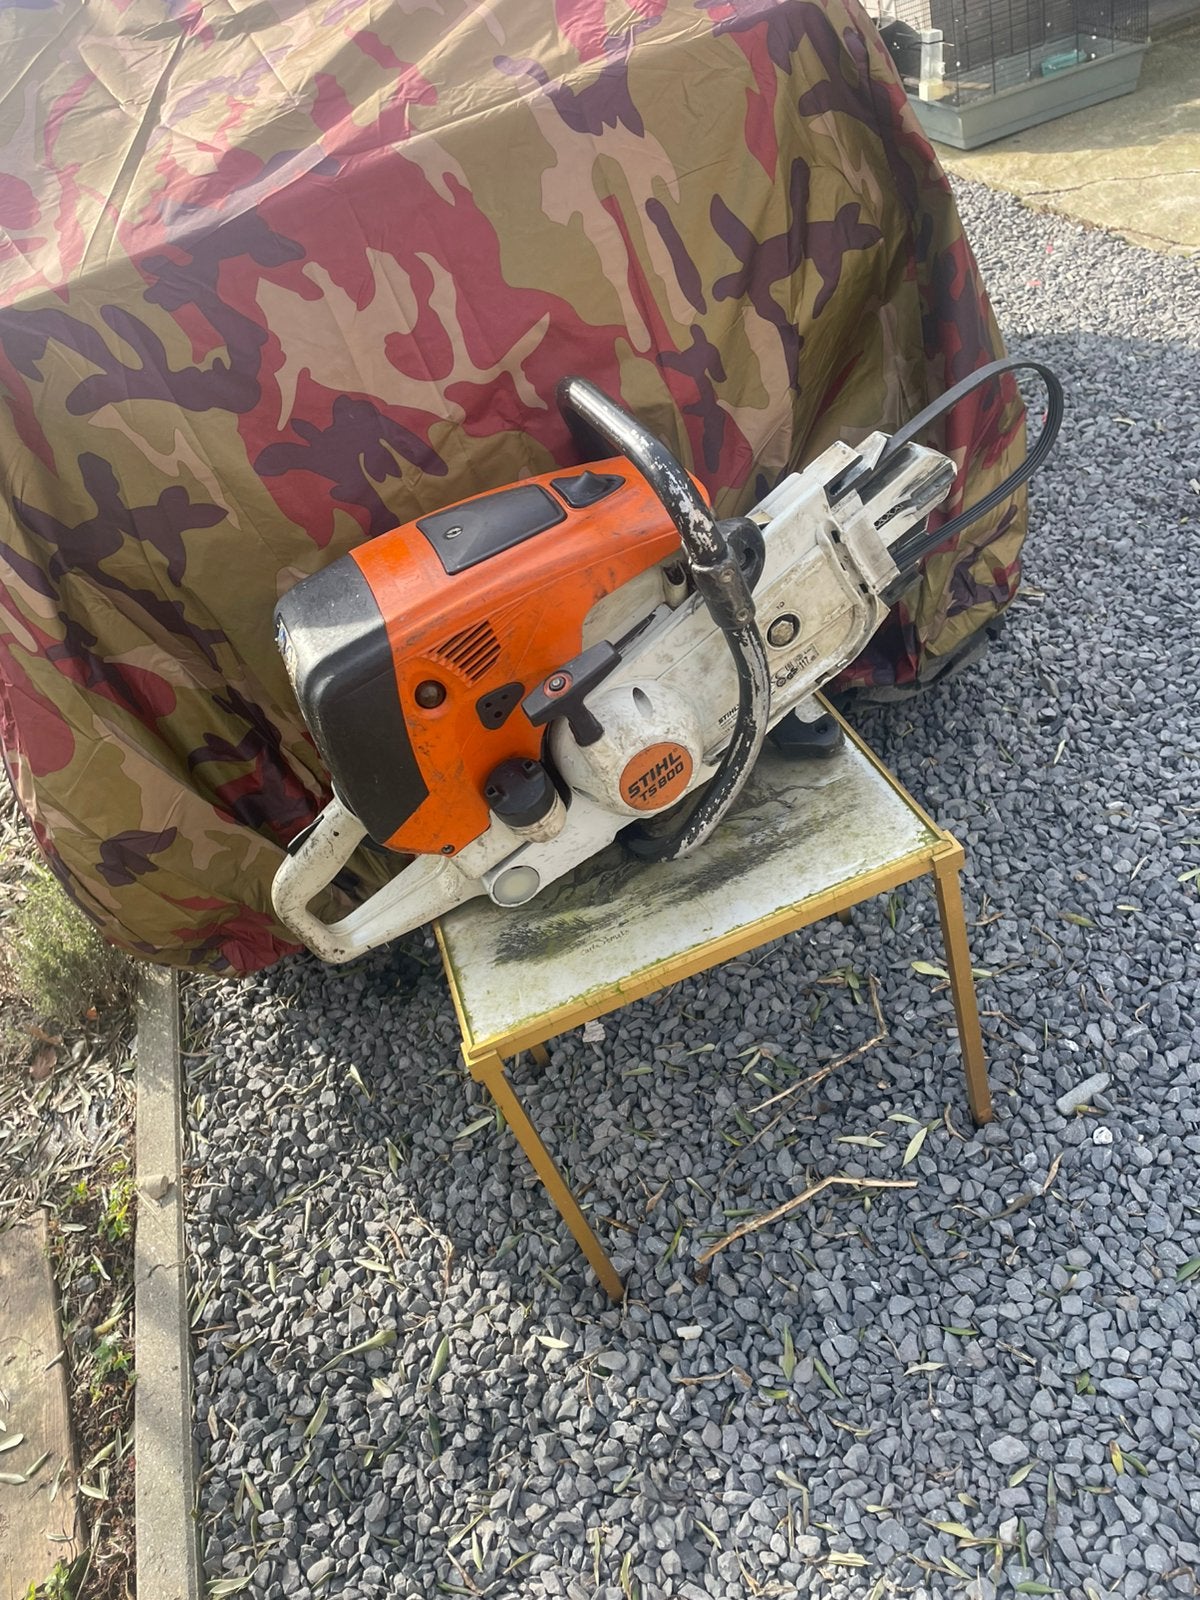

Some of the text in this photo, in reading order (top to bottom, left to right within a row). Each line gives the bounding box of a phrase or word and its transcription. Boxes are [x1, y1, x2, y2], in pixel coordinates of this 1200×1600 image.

[628, 752, 682, 799] STIHL
[640, 761, 684, 801] TS 800
